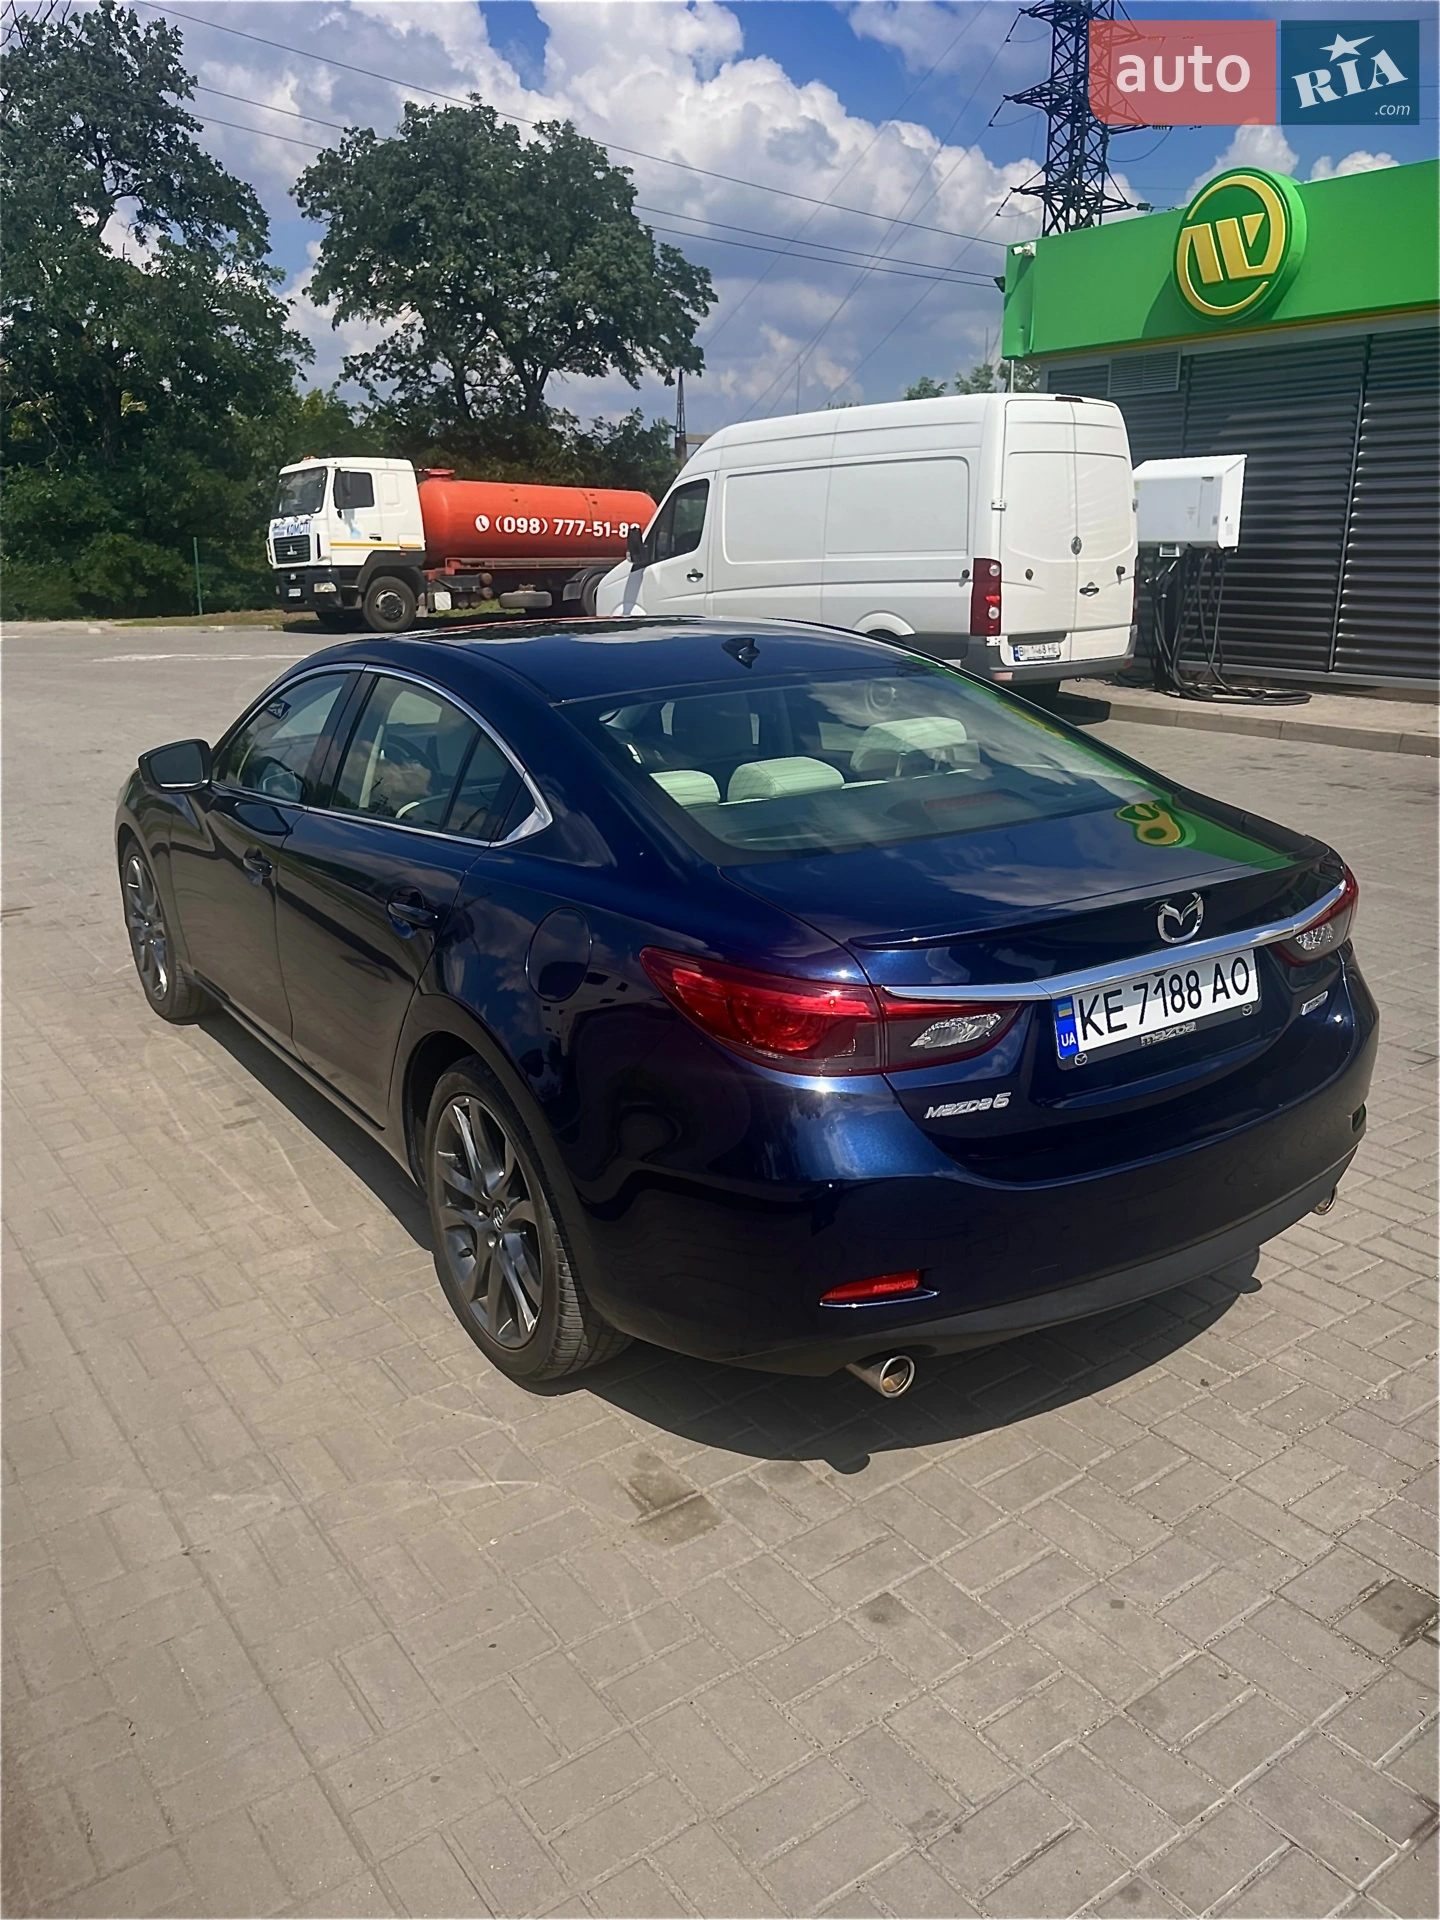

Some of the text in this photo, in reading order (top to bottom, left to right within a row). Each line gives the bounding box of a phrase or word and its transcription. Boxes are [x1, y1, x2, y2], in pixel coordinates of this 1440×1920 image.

[495, 515, 549, 535] (098)
[1078, 988, 1128, 1041] KE
[1133, 969, 1202, 1025] 7188
[1212, 956, 1250, 1003] AO
[1061, 1033, 1076, 1047] UA
